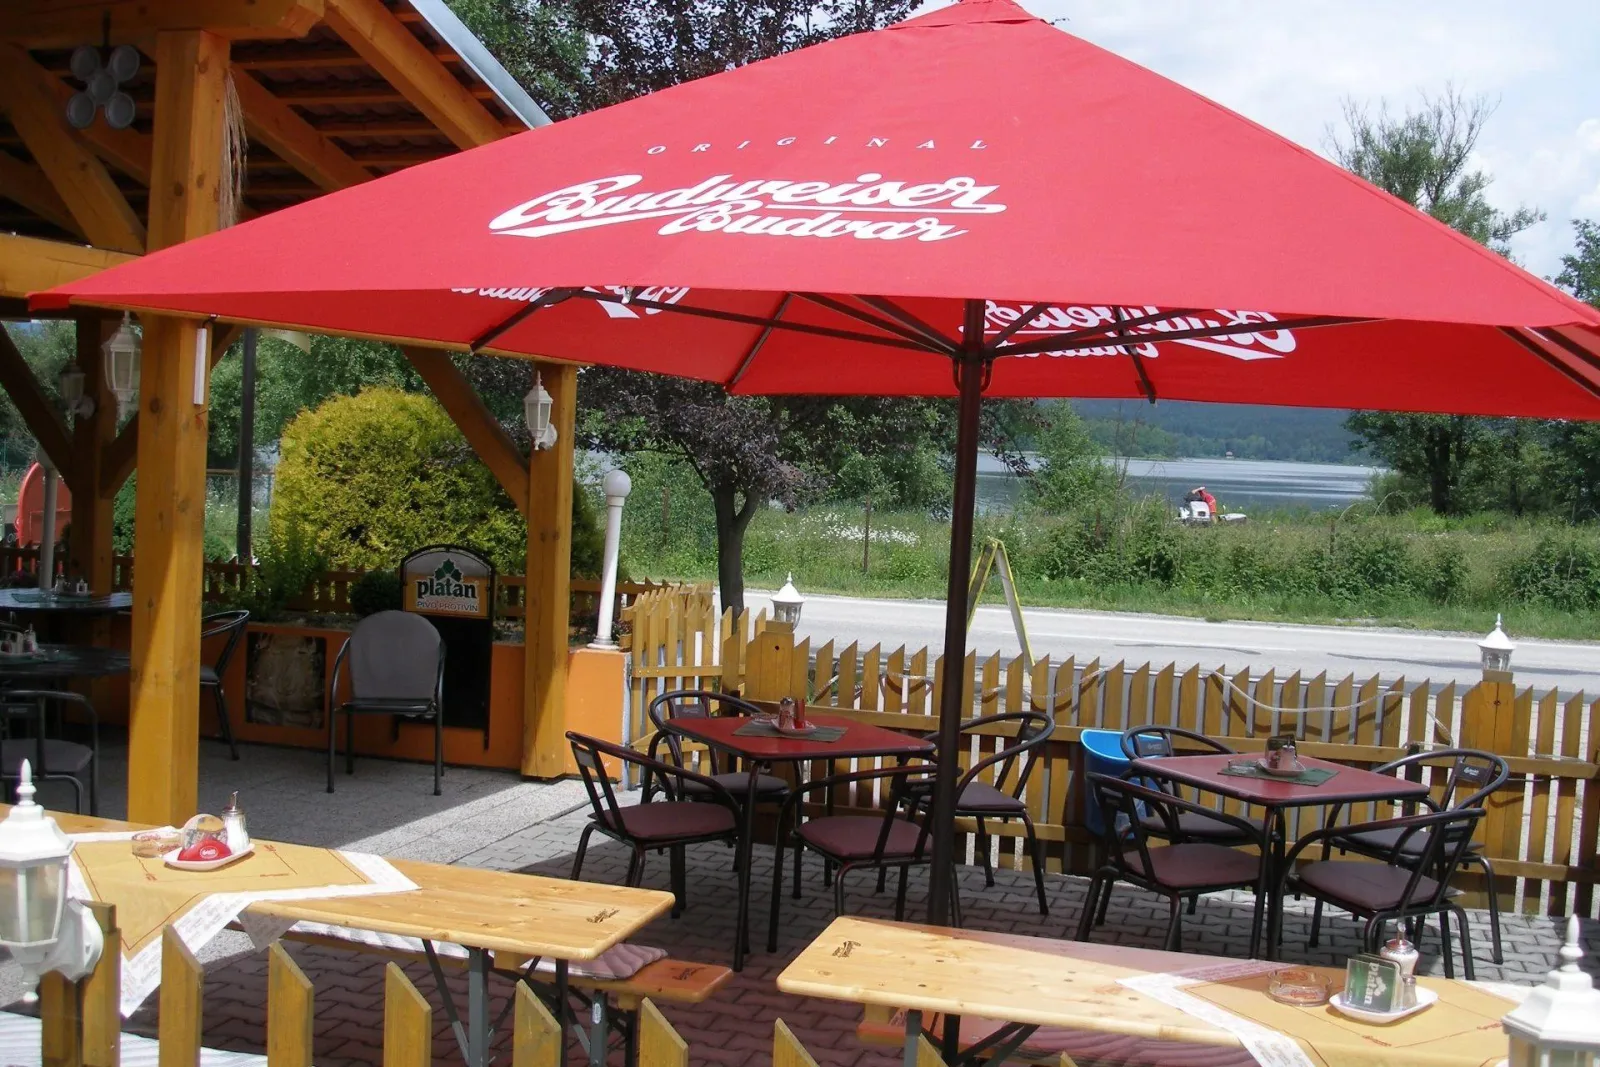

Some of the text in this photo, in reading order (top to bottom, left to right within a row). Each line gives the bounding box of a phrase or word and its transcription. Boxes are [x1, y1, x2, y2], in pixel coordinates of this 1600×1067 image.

[647, 136, 987, 155] ORIGINAL
[488, 172, 1008, 238] Budweiser
[658, 199, 969, 242] Budvar
[417, 577, 478, 599] platan
